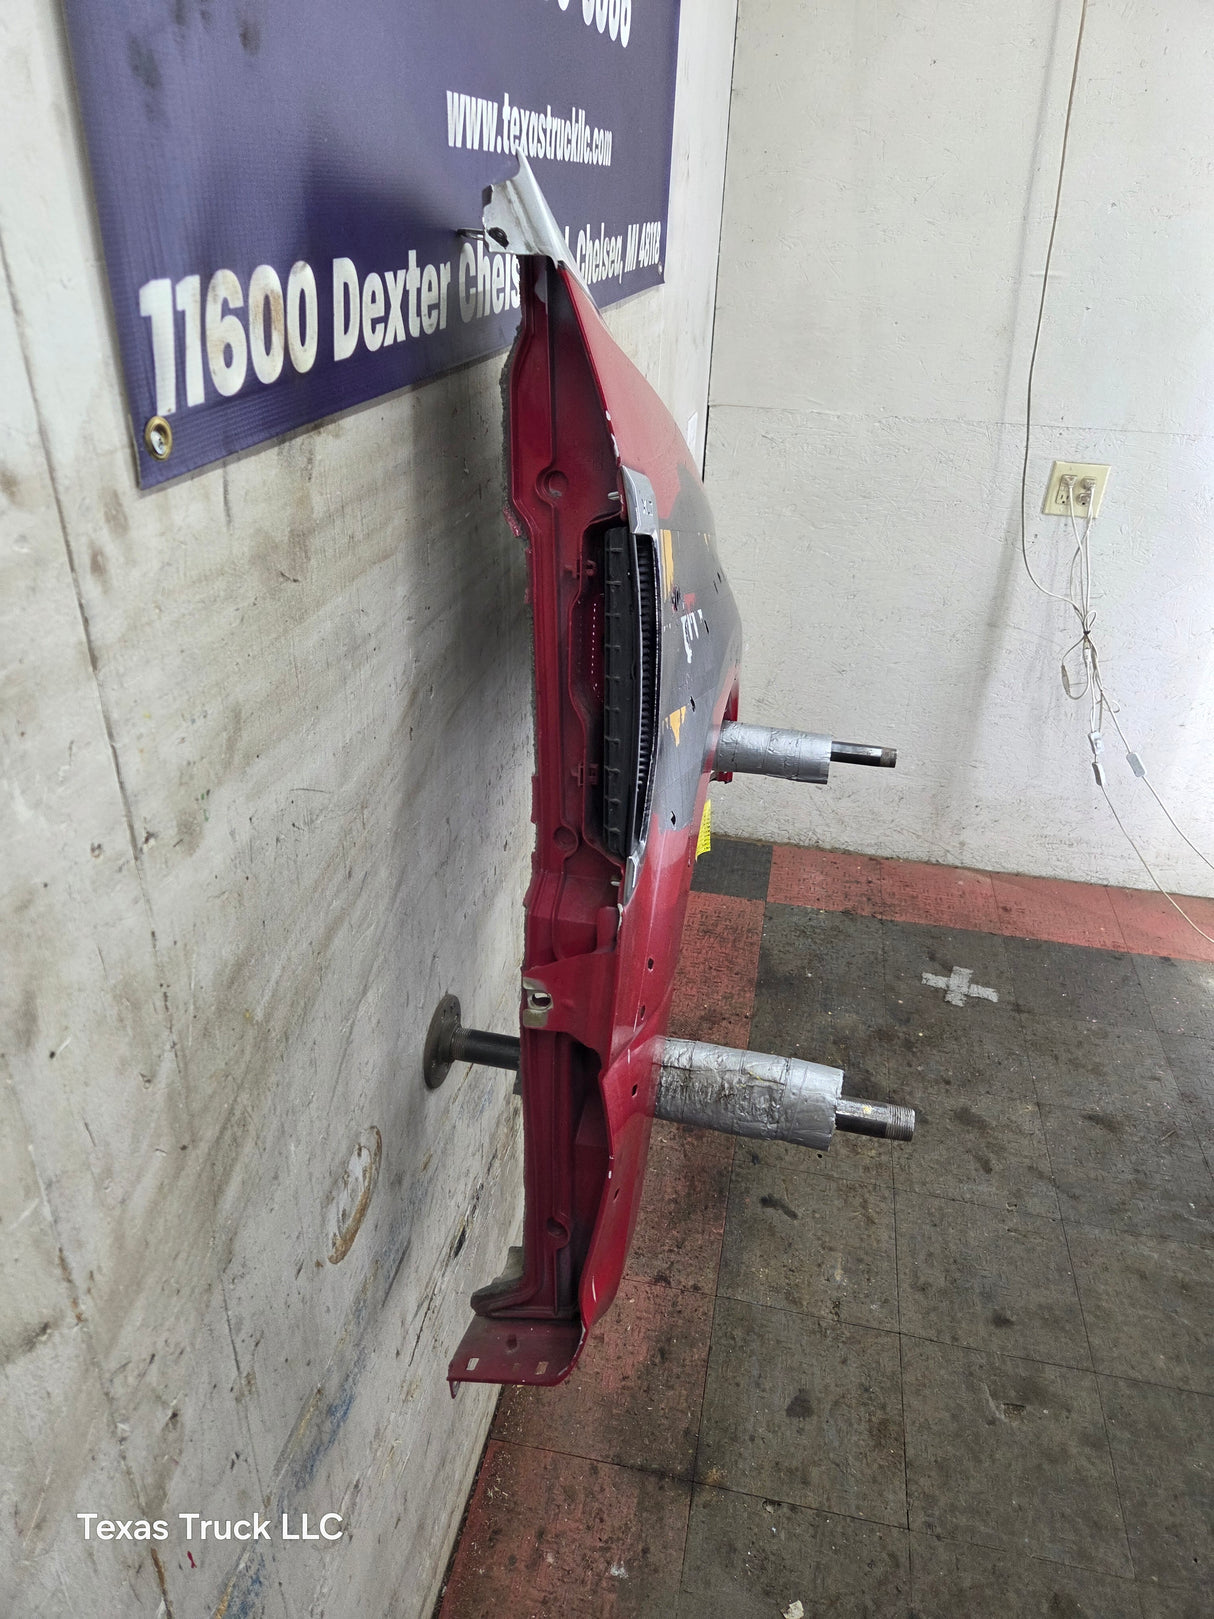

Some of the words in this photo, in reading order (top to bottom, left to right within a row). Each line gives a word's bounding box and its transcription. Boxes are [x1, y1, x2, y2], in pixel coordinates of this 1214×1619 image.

[446, 89, 613, 167] www.texastruckllc.com
[139, 260, 318, 417] 11600
[333, 249, 451, 362] Dexter
[458, 239, 521, 324] Chels
[577, 222, 623, 285] Chelsea,
[625, 223, 640, 273] MI
[639, 221, 662, 268] 48118
